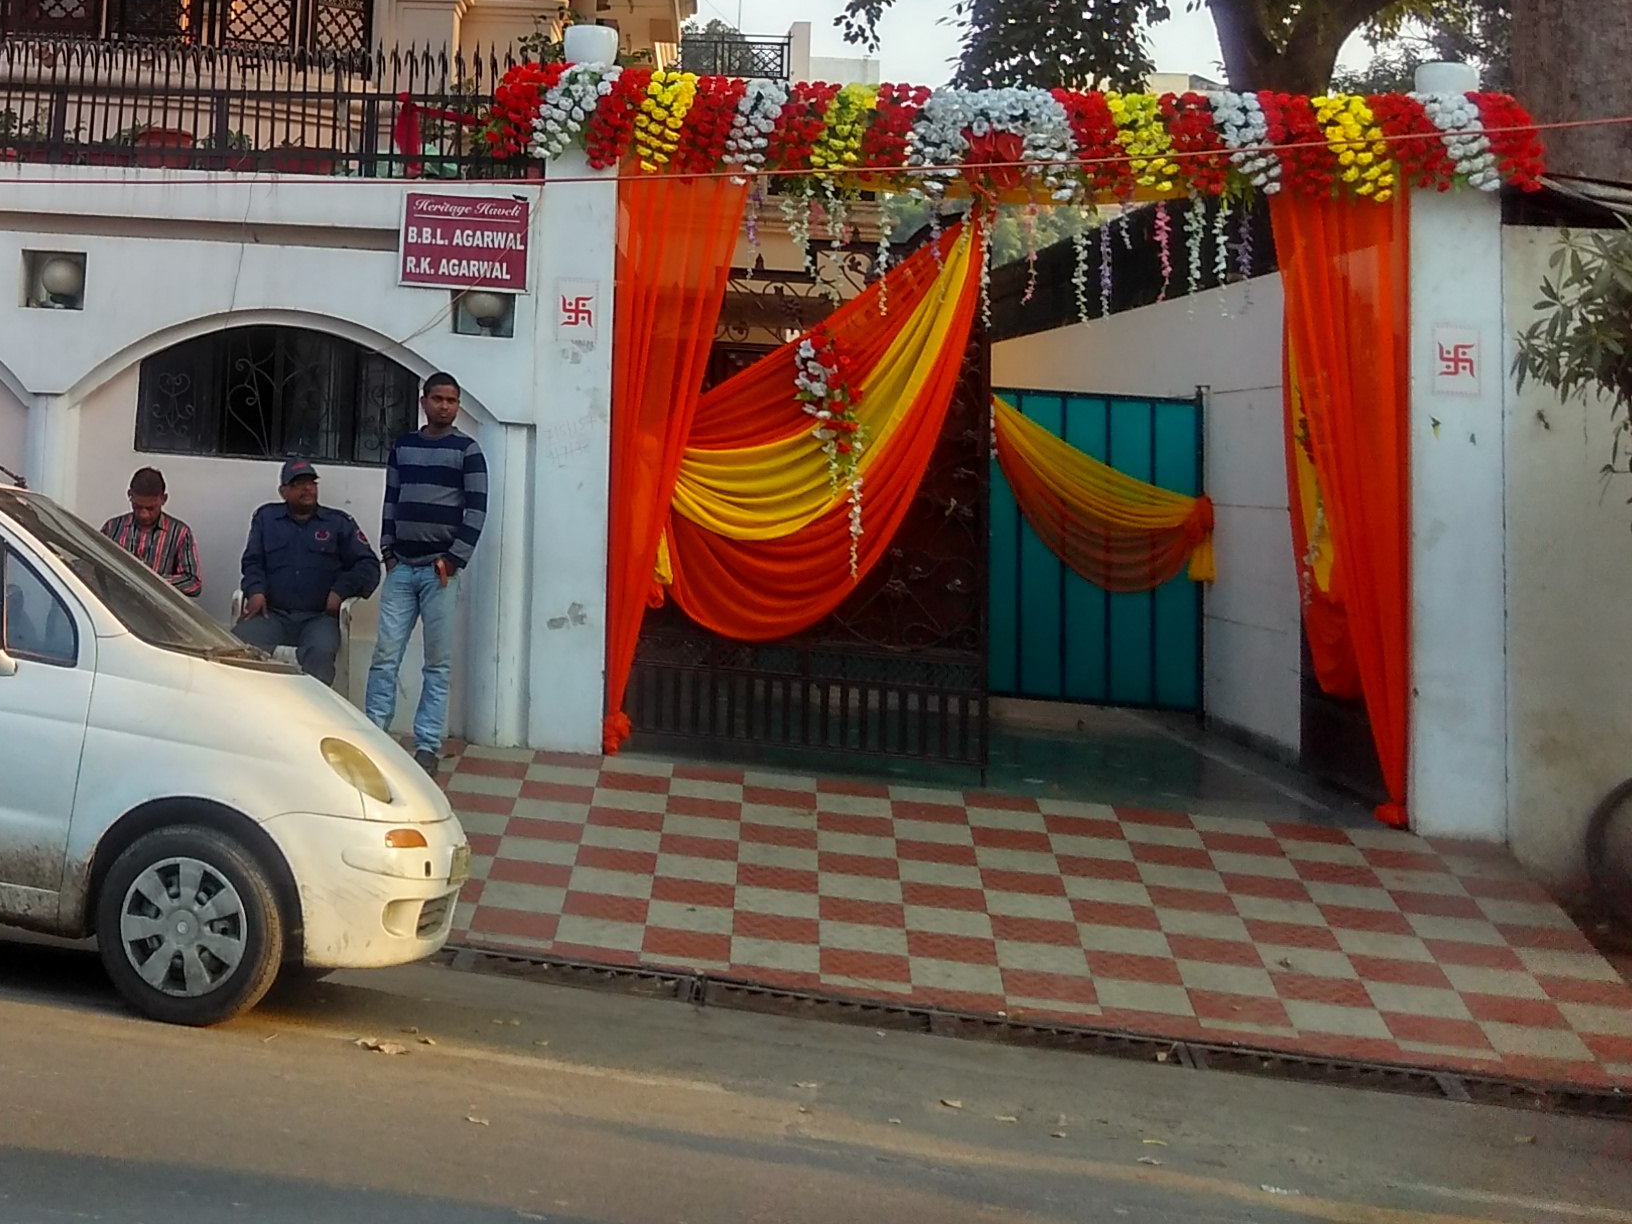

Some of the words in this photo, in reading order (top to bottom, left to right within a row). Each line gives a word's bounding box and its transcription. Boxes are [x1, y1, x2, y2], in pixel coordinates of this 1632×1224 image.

[413, 199, 473, 217] Heritage
[474, 202, 522, 217] Haveli
[407, 226, 449, 245] B.B.L.
[452, 229, 525, 250] AGARWAL
[406, 256, 435, 275] R.K.
[438, 258, 511, 280] AGARWAL
